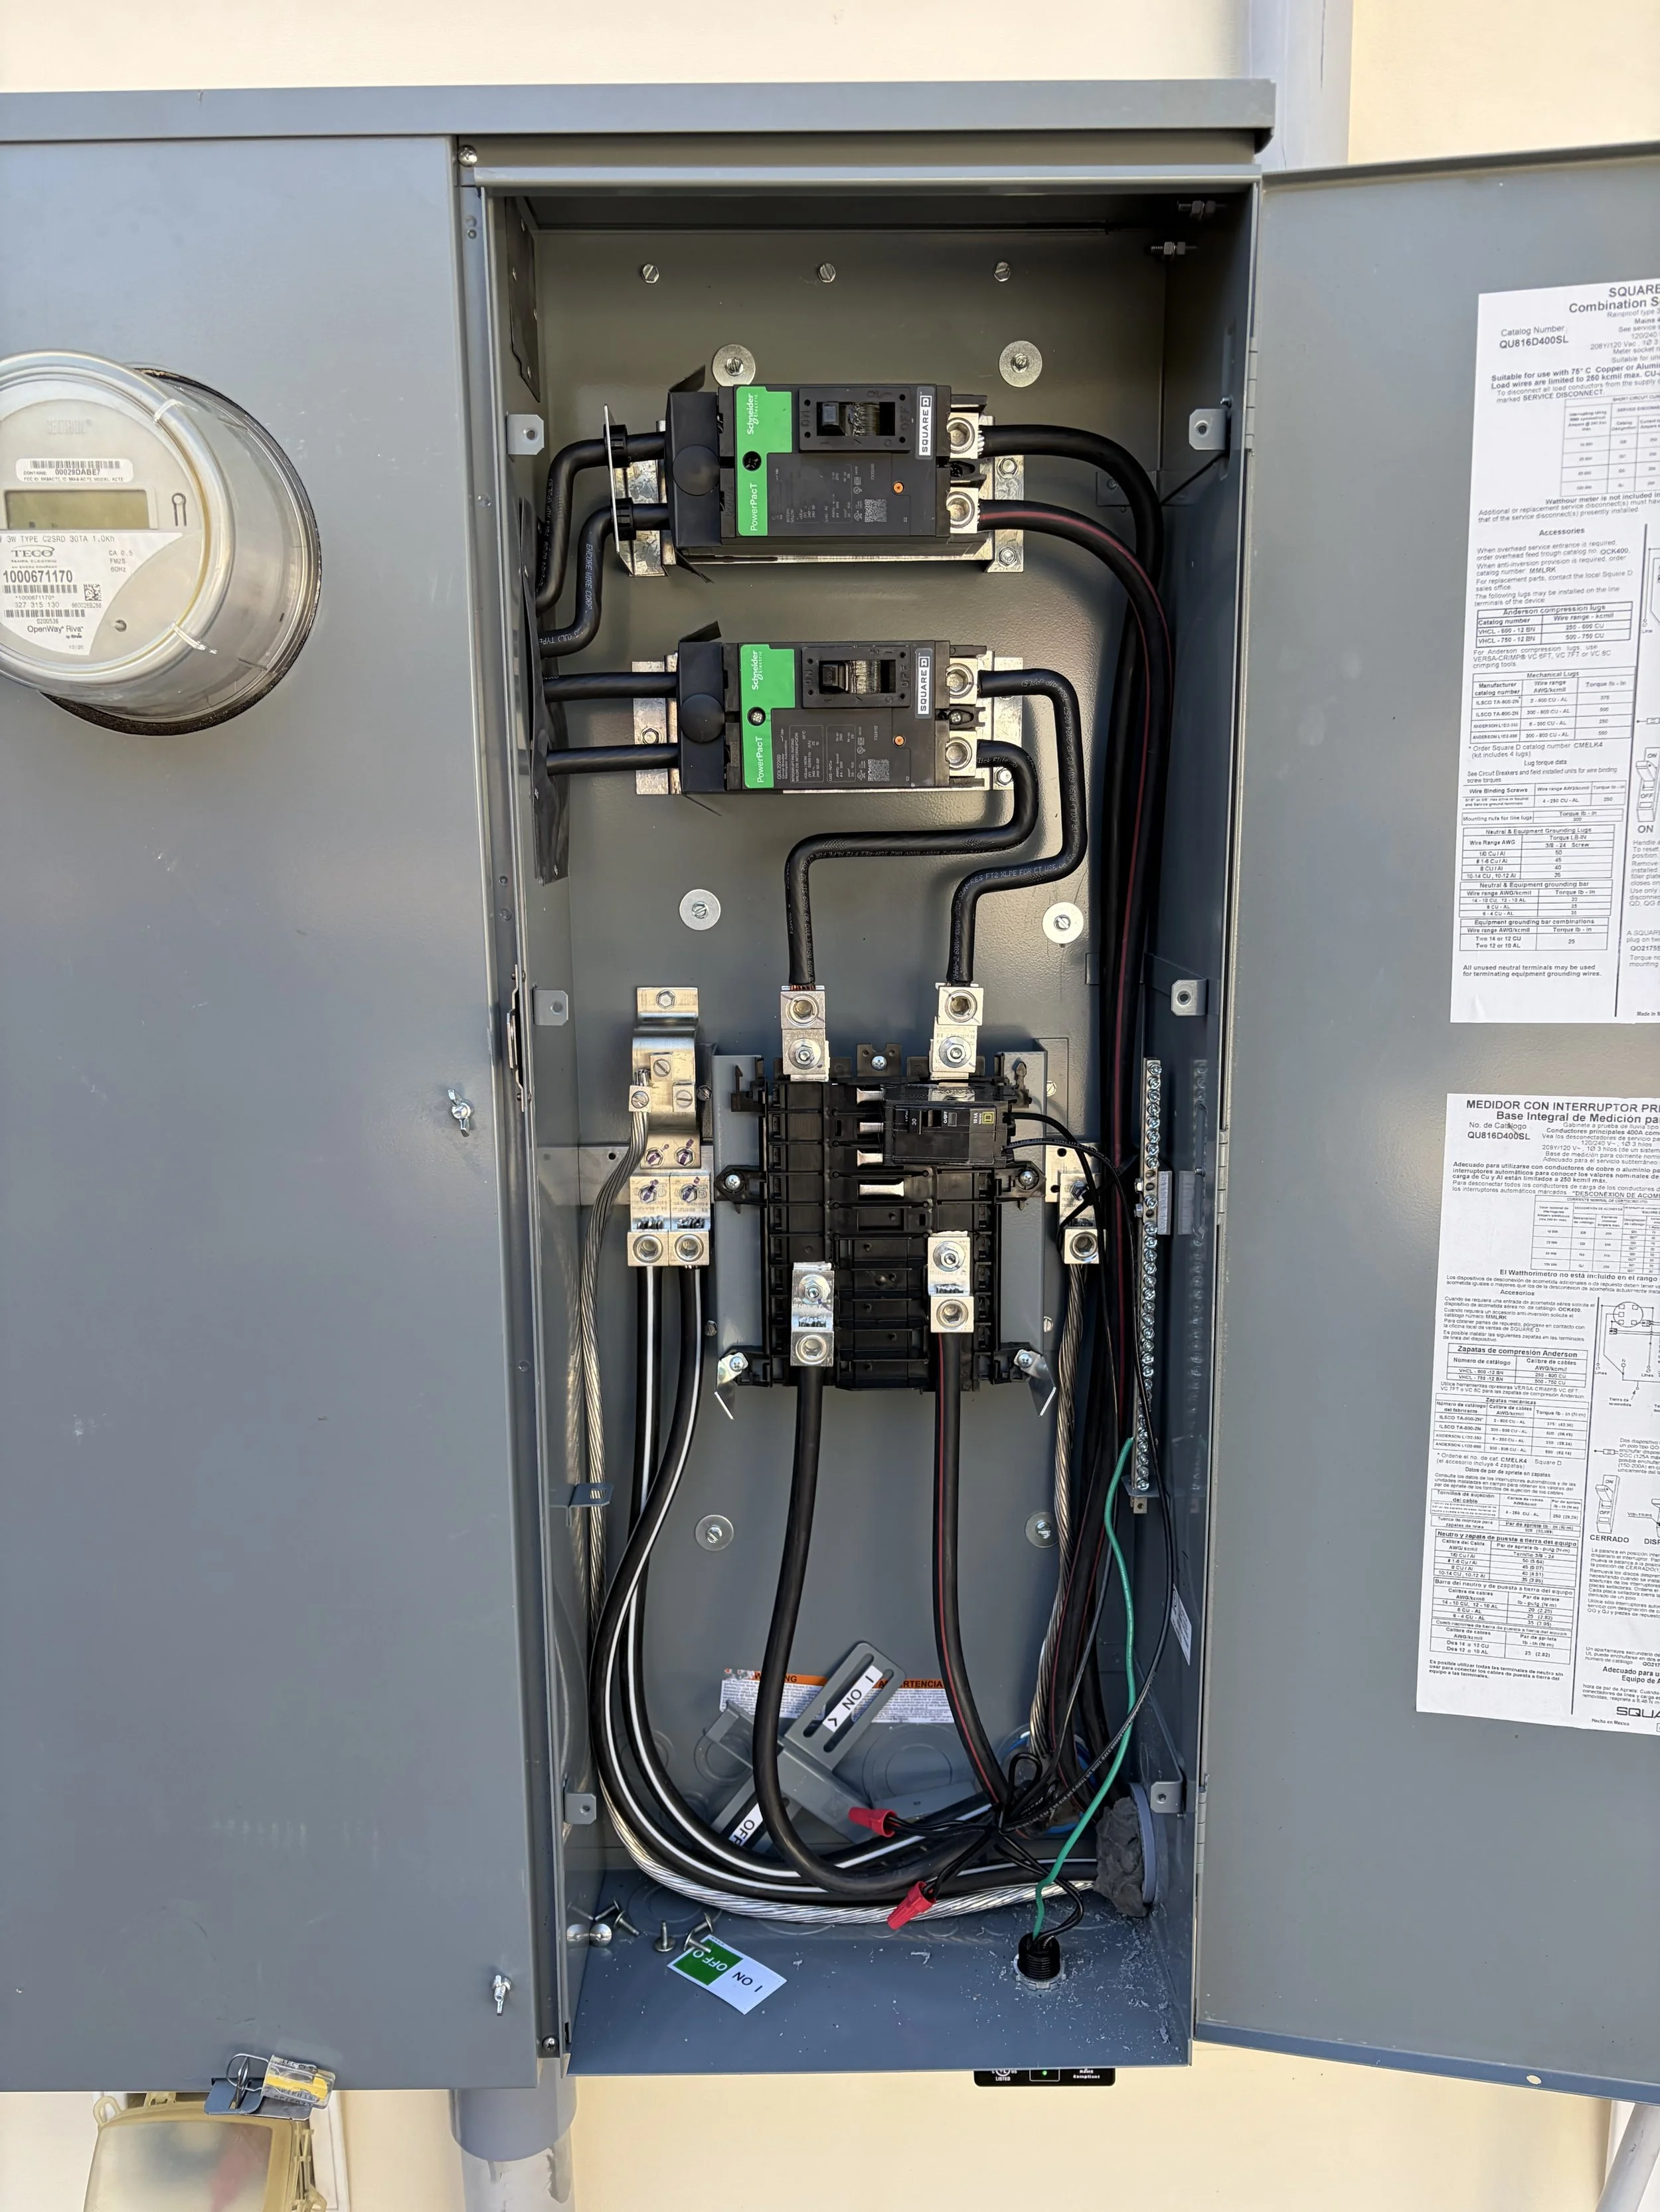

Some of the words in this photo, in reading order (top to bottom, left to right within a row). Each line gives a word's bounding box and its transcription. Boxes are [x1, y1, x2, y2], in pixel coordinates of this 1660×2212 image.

[1569, 299, 1647, 313] Combination
[1501, 328, 1531, 337] Catalog
[1499, 335, 1568, 349] QU816D400SL
[1491, 373, 1522, 382] Suitable
[1596, 366, 1623, 375] Copper
[1539, 527, 1586, 536] Accessories
[3, 570, 72, 583] 1000671170
[1637, 825, 1654, 833] ON
[1466, 1100, 1521, 1109] MEDIDOR
[1524, 1101, 1549, 1110] CON
[1552, 1102, 1637, 1113] INTERRUPTOR
[1497, 1111, 1523, 1120] Base
[1527, 1112, 1568, 1123] Integral
[1572, 1113, 1586, 1122] de
[1590, 1113, 1641, 1123] Medición
[1467, 1131, 1531, 1140] QU816D400SL
[1590, 1534, 1629, 1543] CERRADO
[1602, 1666, 1637, 1675] Adecuado
[1621, 1675, 1645, 1684] Equipo
[842, 1689, 862, 1710] ON
[733, 1820, 755, 1846] OFF
[702, 1956, 728, 1972] OFF
[732, 1971, 754, 1986] ON
